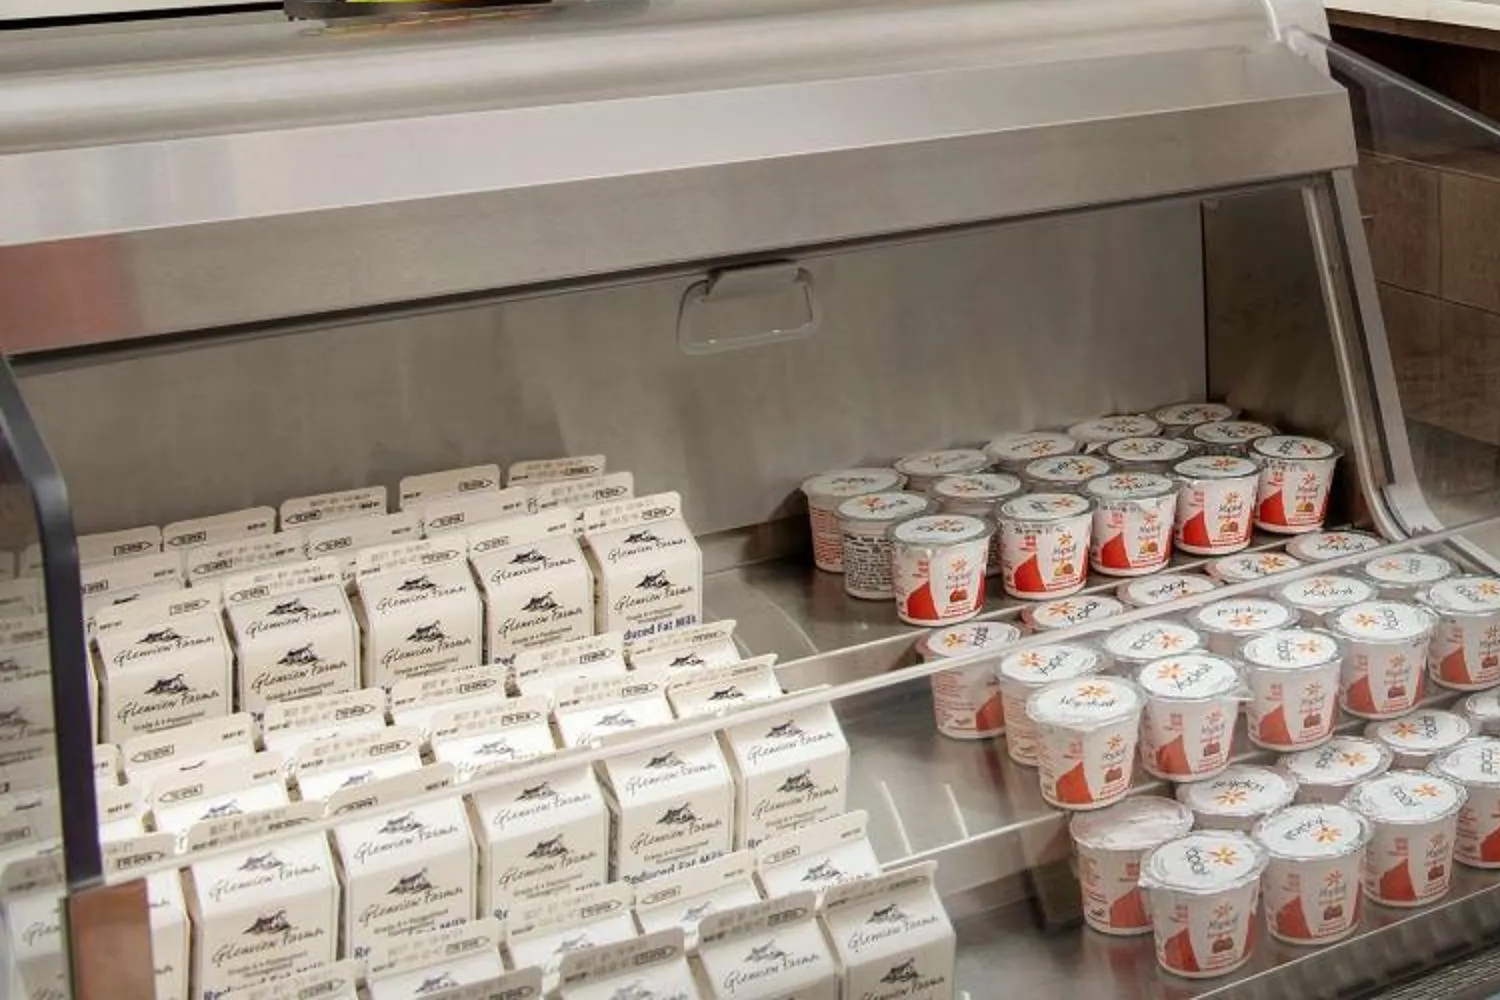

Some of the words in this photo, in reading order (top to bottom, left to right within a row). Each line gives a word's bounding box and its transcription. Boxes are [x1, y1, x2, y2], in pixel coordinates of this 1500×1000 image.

[608, 545, 652, 564] Glenview
[655, 537, 687, 551] Farms
[491, 565, 540, 584] Glenview
[542, 557, 576, 570] Farms
[376, 593, 429, 612] Glenview
[431, 584, 467, 597] Farms
[614, 592, 661, 614] Glenview
[663, 585, 694, 601] Farms
[246, 616, 301, 639] Glenview
[303, 607, 342, 624] Farms
[498, 615, 548, 639] Glenview
[551, 607, 583, 621] Farms
[623, 623, 655, 641] duced
[657, 619, 673, 632] Fat
[675, 614, 697, 628] Milk
[113, 644, 171, 668] Glenview
[175, 635, 216, 653] Farms
[381, 645, 434, 669] Glenview
[437, 636, 472, 651] Farms
[251, 670, 308, 694] Glenview
[310, 660, 348, 676] Farms
[117, 700, 176, 724] Glenview
[180, 690, 220, 706] Farms
[747, 742, 797, 766] Glenview
[799, 731, 835, 747] Farms
[625, 772, 678, 796] Glenview
[680, 761, 717, 777] Farms
[493, 804, 549, 830] Glenview
[553, 793, 592, 810] Farms
[752, 796, 804, 820] Glenview
[806, 785, 839, 801] Farms
[354, 836, 416, 864] Glenview
[418, 824, 459, 841] Farms
[629, 830, 685, 855] Glenview
[688, 818, 722, 835] Farms
[208, 874, 275, 902] Glenview
[278, 864, 321, 881] Farms
[498, 863, 555, 889] Glenview
[559, 851, 597, 869] Farms
[359, 897, 421, 926] Glenview
[423, 886, 463, 905] Farms
[212, 938, 277, 969] Glenview
[281, 927, 325, 946] Farms
[847, 926, 902, 953] Glenview
[903, 914, 939, 933] Farms
[724, 963, 780, 994] Glenview
[782, 952, 820, 970] Farms
